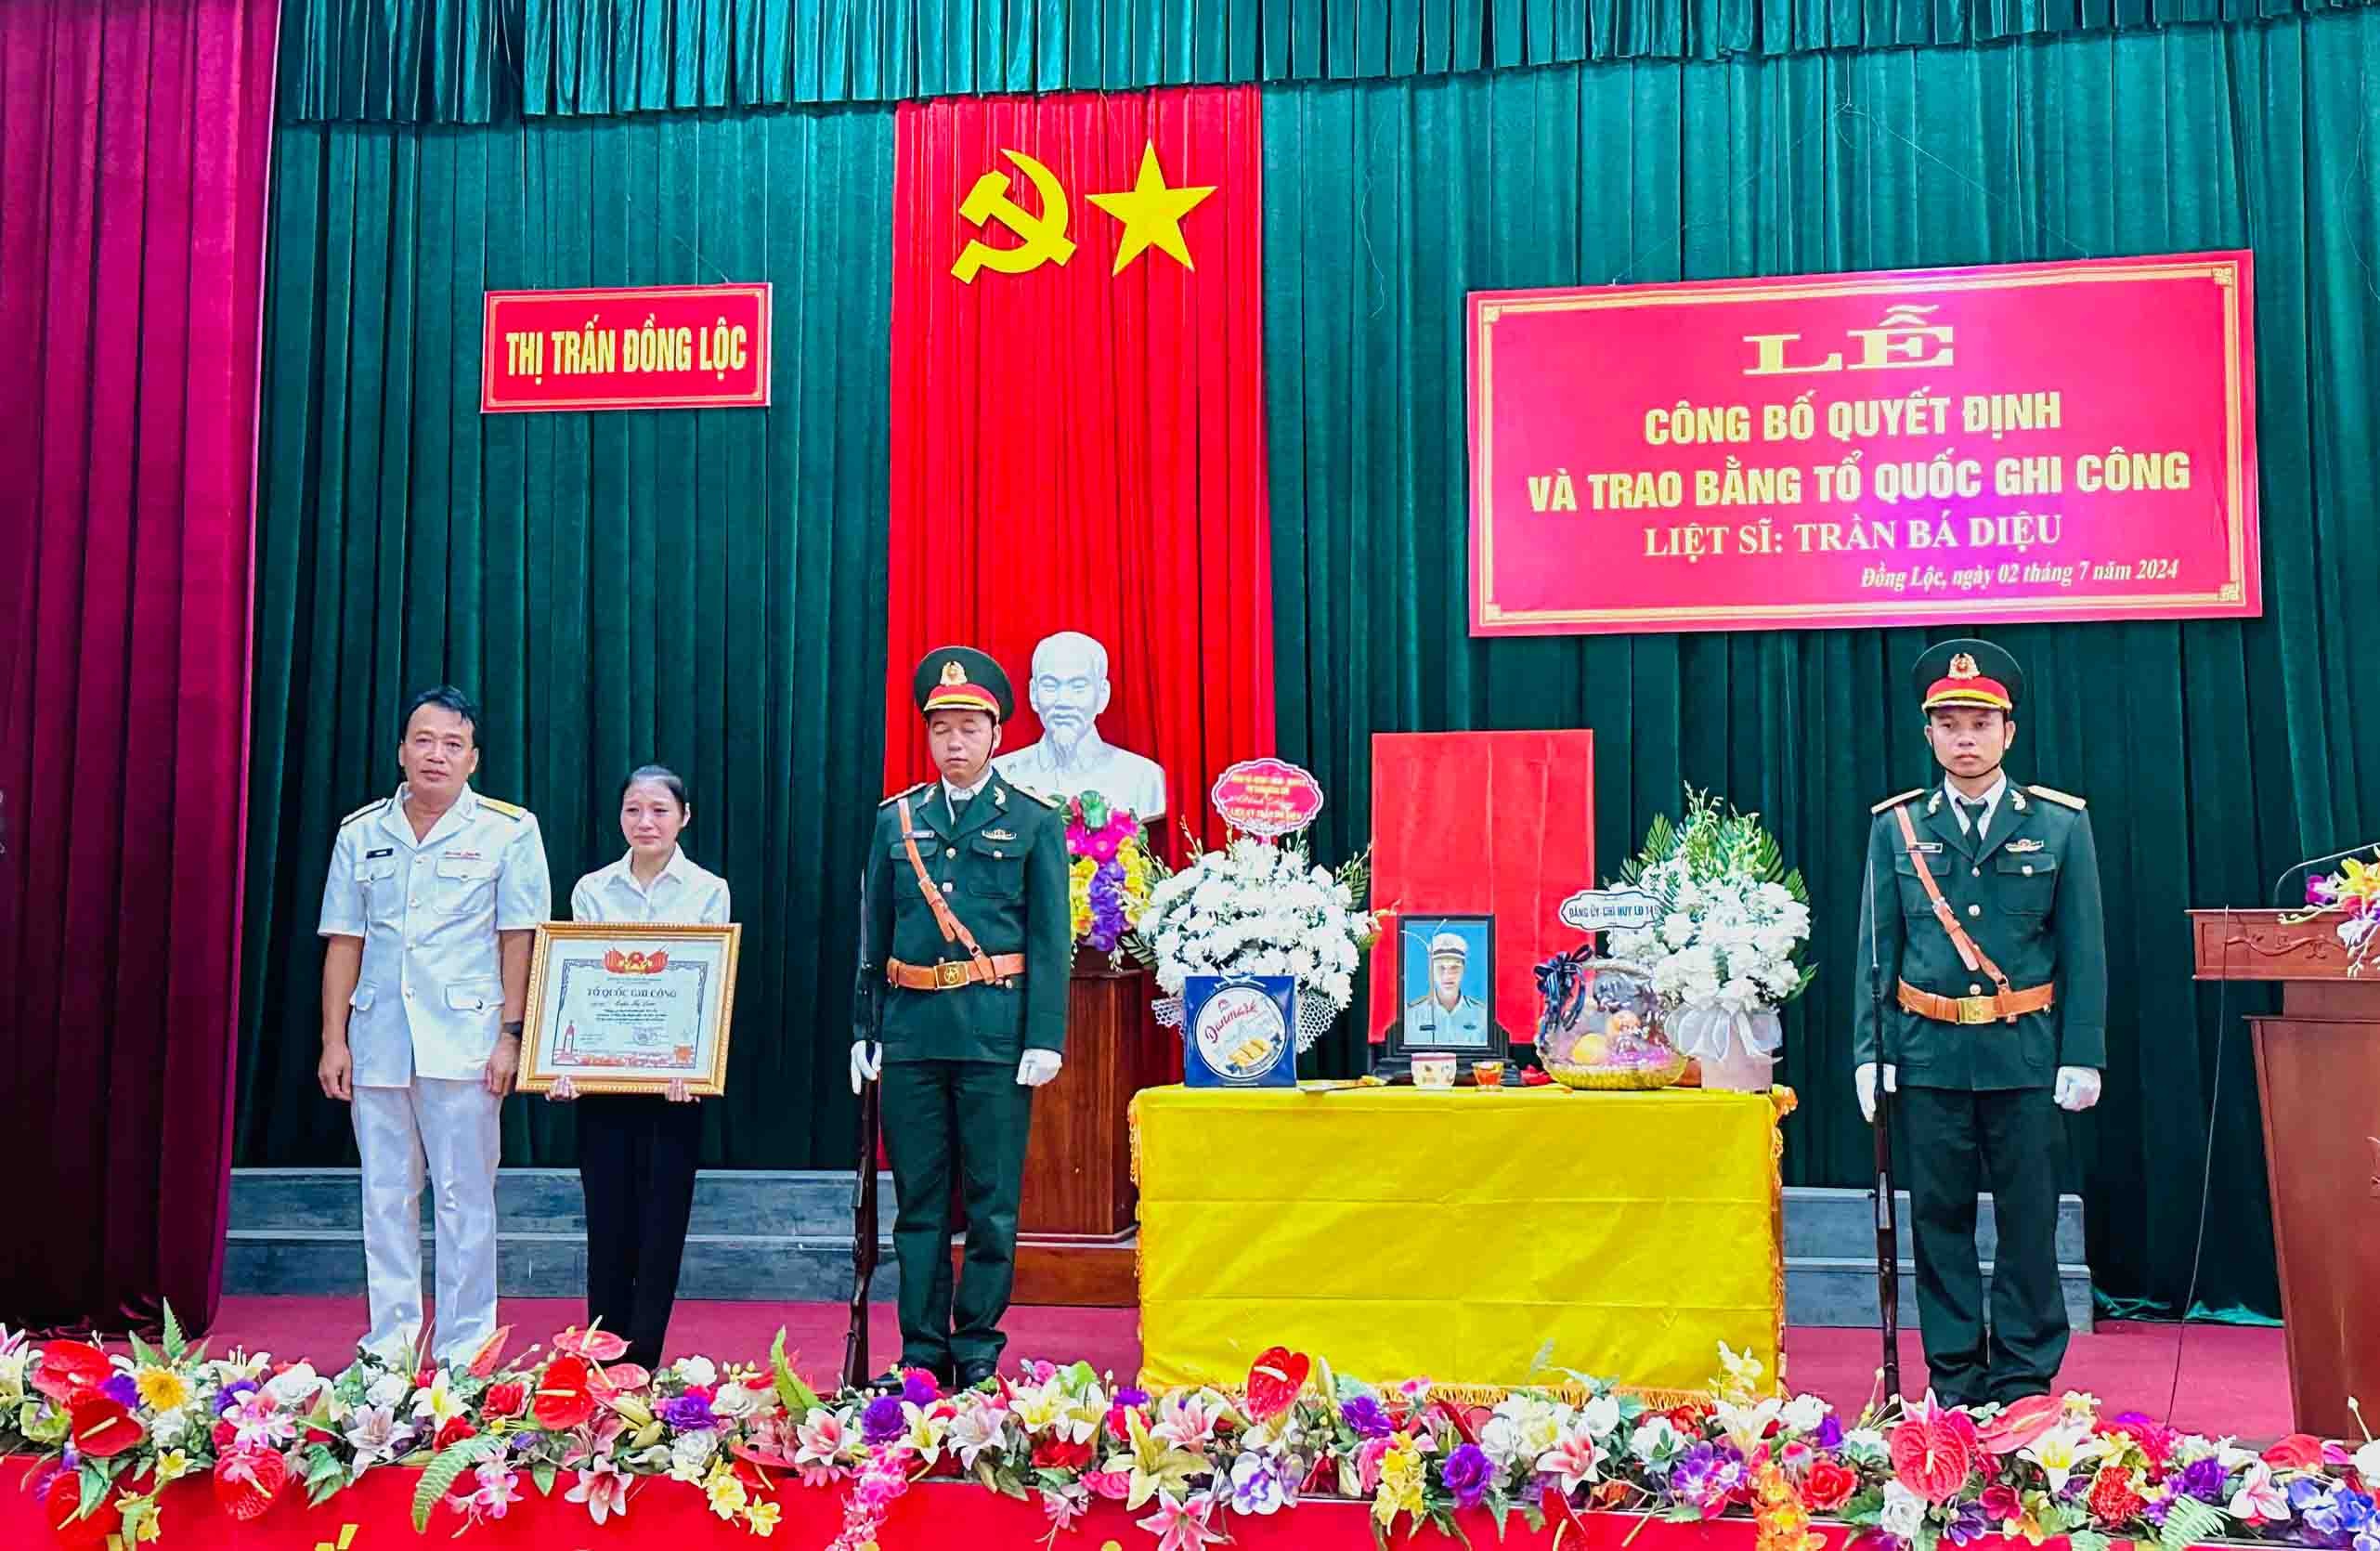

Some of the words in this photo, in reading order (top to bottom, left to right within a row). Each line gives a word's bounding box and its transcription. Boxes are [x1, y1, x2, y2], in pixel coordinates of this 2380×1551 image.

[506, 332, 543, 384] THỊ
[551, 314, 616, 375] TRẤN
[623, 313, 692, 372] ĐỒNG
[699, 316, 747, 381] LỘC
[1743, 304, 1954, 375] LỄ
[1645, 400, 1751, 445] CÔNG
[1763, 389, 1816, 441] BỐ
[1827, 385, 1951, 442] QUYẾT
[1961, 391, 2061, 439] ĐỊNH
[1528, 468, 1577, 512] VÀ
[1587, 471, 1683, 510] TRAO
[1694, 454, 1801, 506] BẰNG
[1813, 449, 1864, 503] TỔ
[1874, 447, 1983, 505] QUỐC
[1996, 456, 2062, 497] GHI
[2076, 446, 2191, 493] CÔNG
[1644, 522, 1730, 563] LIỆT
[1738, 517, 1784, 554] SĨ:
[1792, 514, 1896, 554] TRẦN
[1907, 509, 1960, 550] BÁ
[1968, 510, 2062, 554] DIỆU
[1860, 560, 1907, 592] Đồng
[1909, 565, 1947, 594] Lộc,
[1952, 565, 1994, 591] ngày
[1997, 563, 2020, 584] 02
[2022, 561, 2073, 587] tháng
[2079, 560, 2090, 581] 7
[2092, 561, 2131, 581] năm
[2135, 558, 2179, 580] 2024
